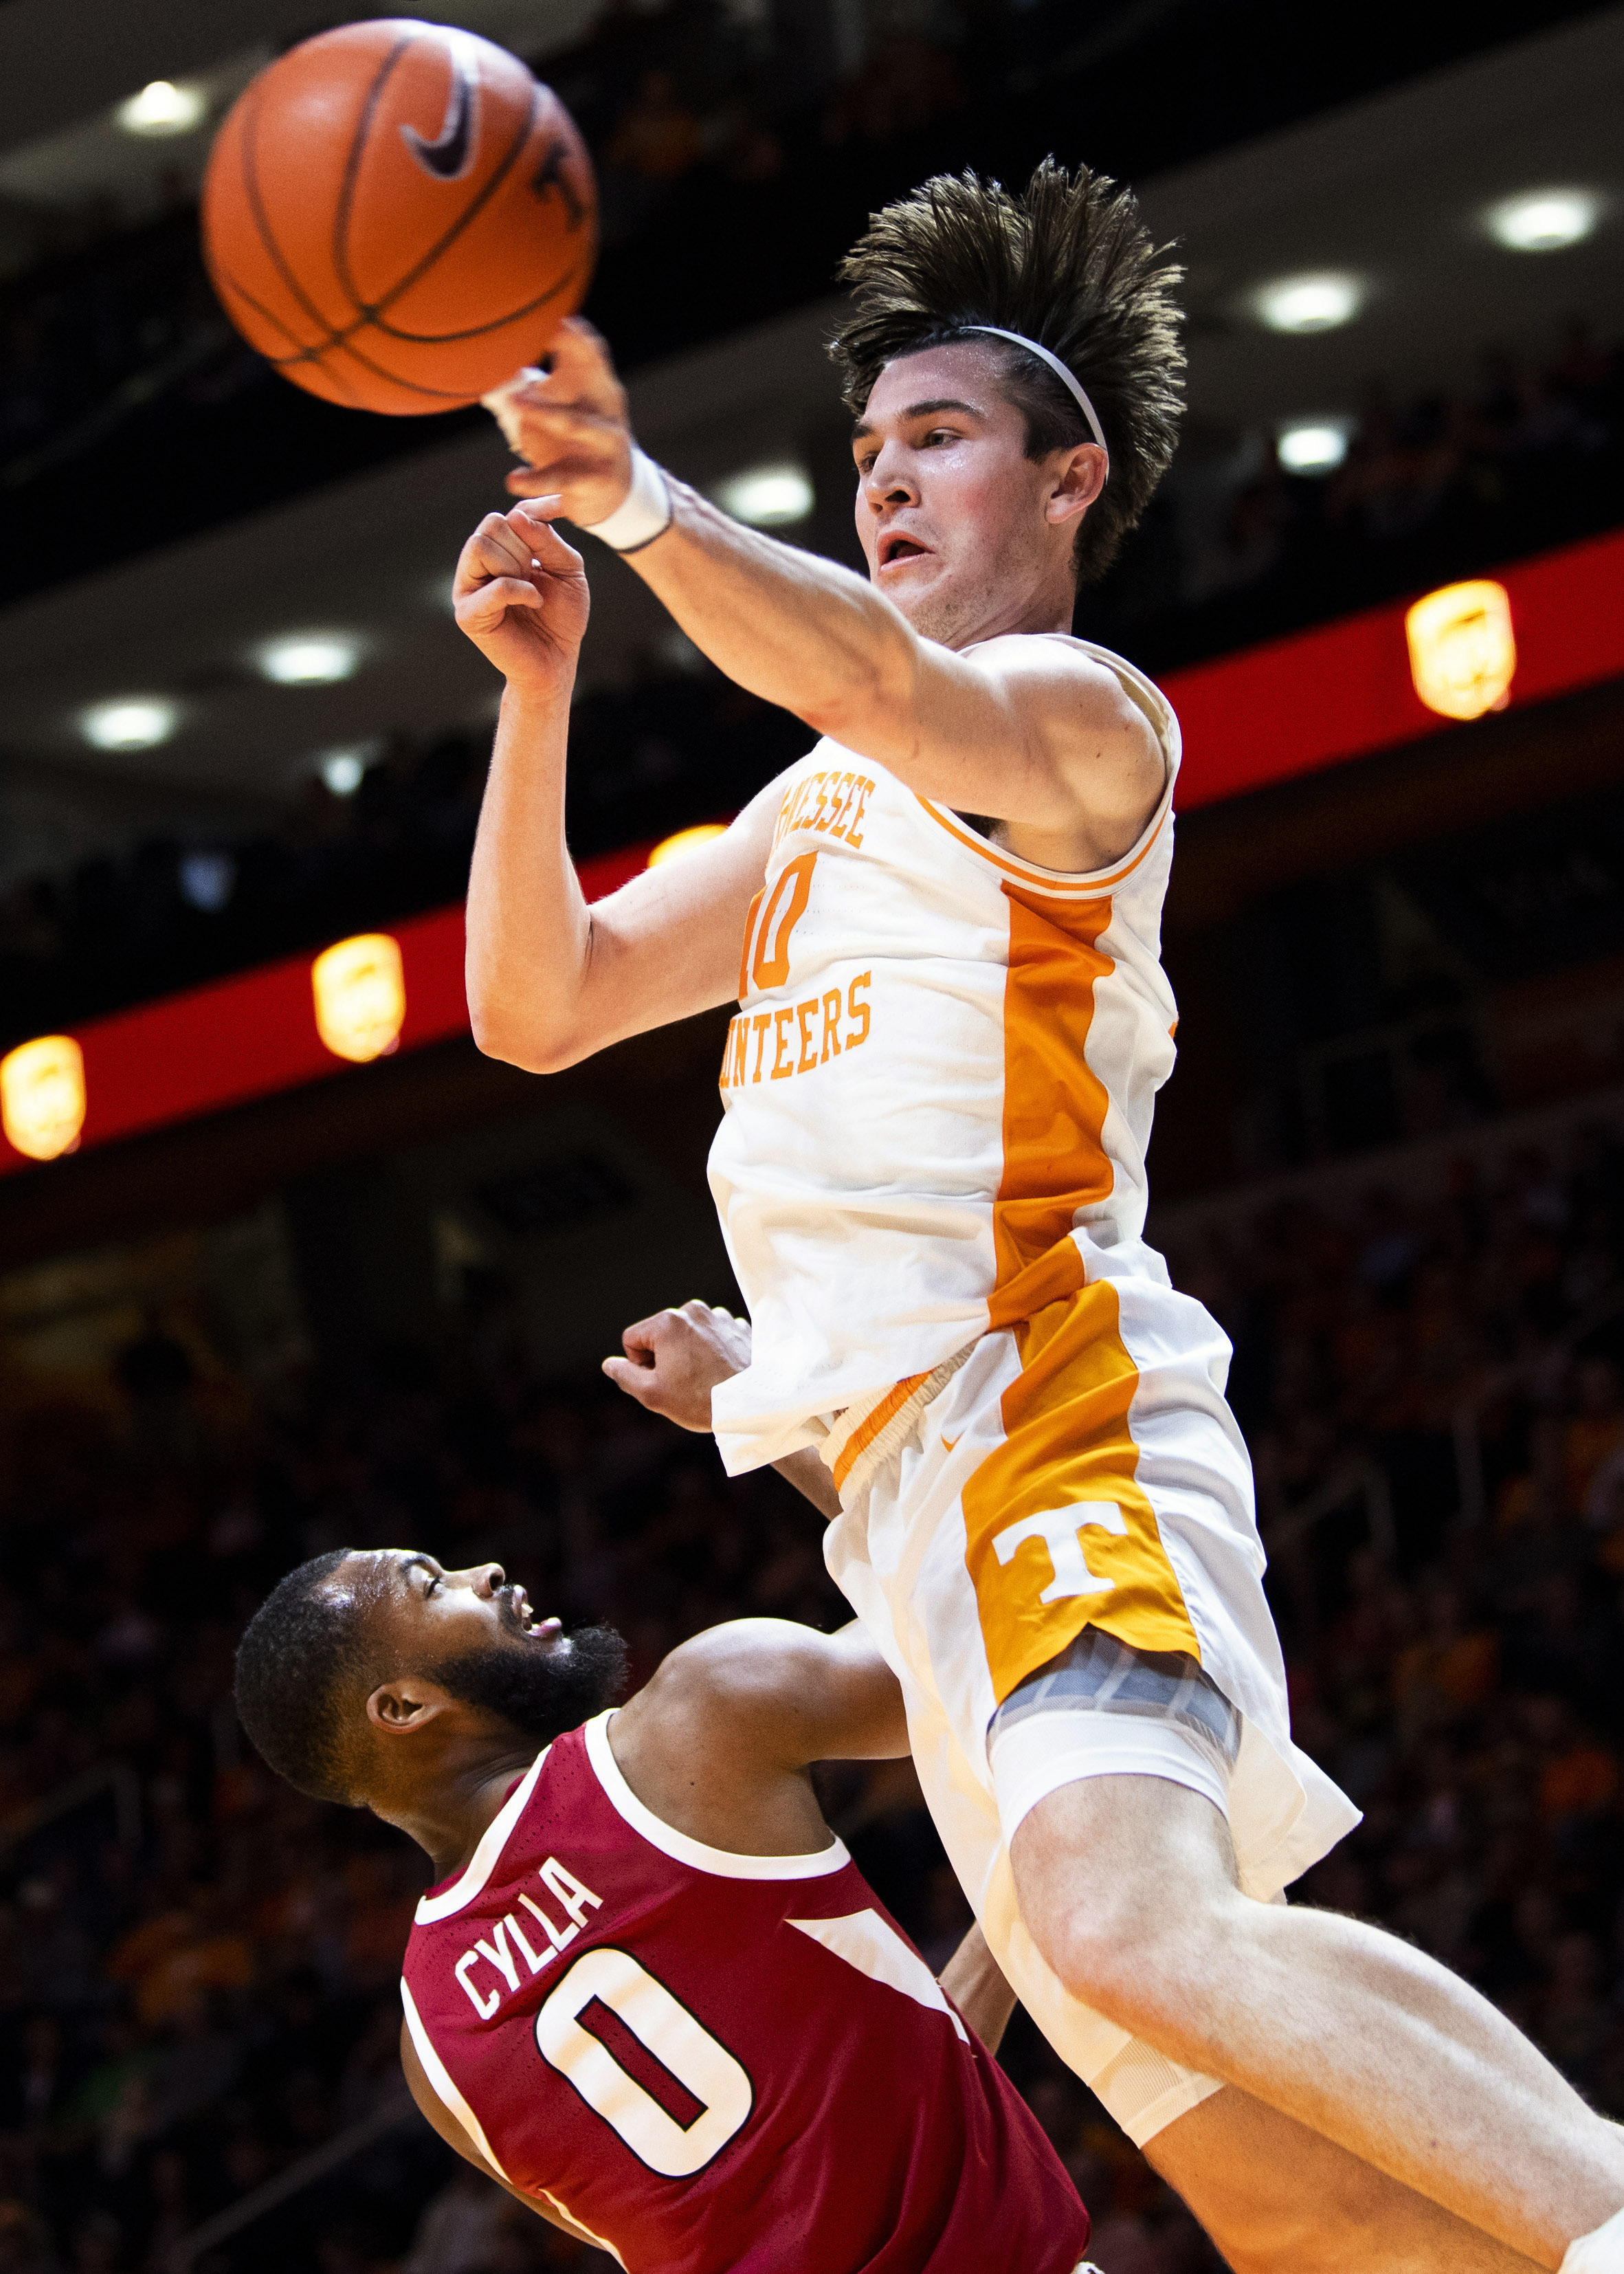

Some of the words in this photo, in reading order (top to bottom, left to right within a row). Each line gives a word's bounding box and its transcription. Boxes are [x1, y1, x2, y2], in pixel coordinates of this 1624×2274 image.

[719, 970, 871, 1089] UNTEERS
[992, 1501, 1128, 1605] T
[454, 1856, 604, 2020] CYLLA
[533, 1943, 755, 2181] 0
